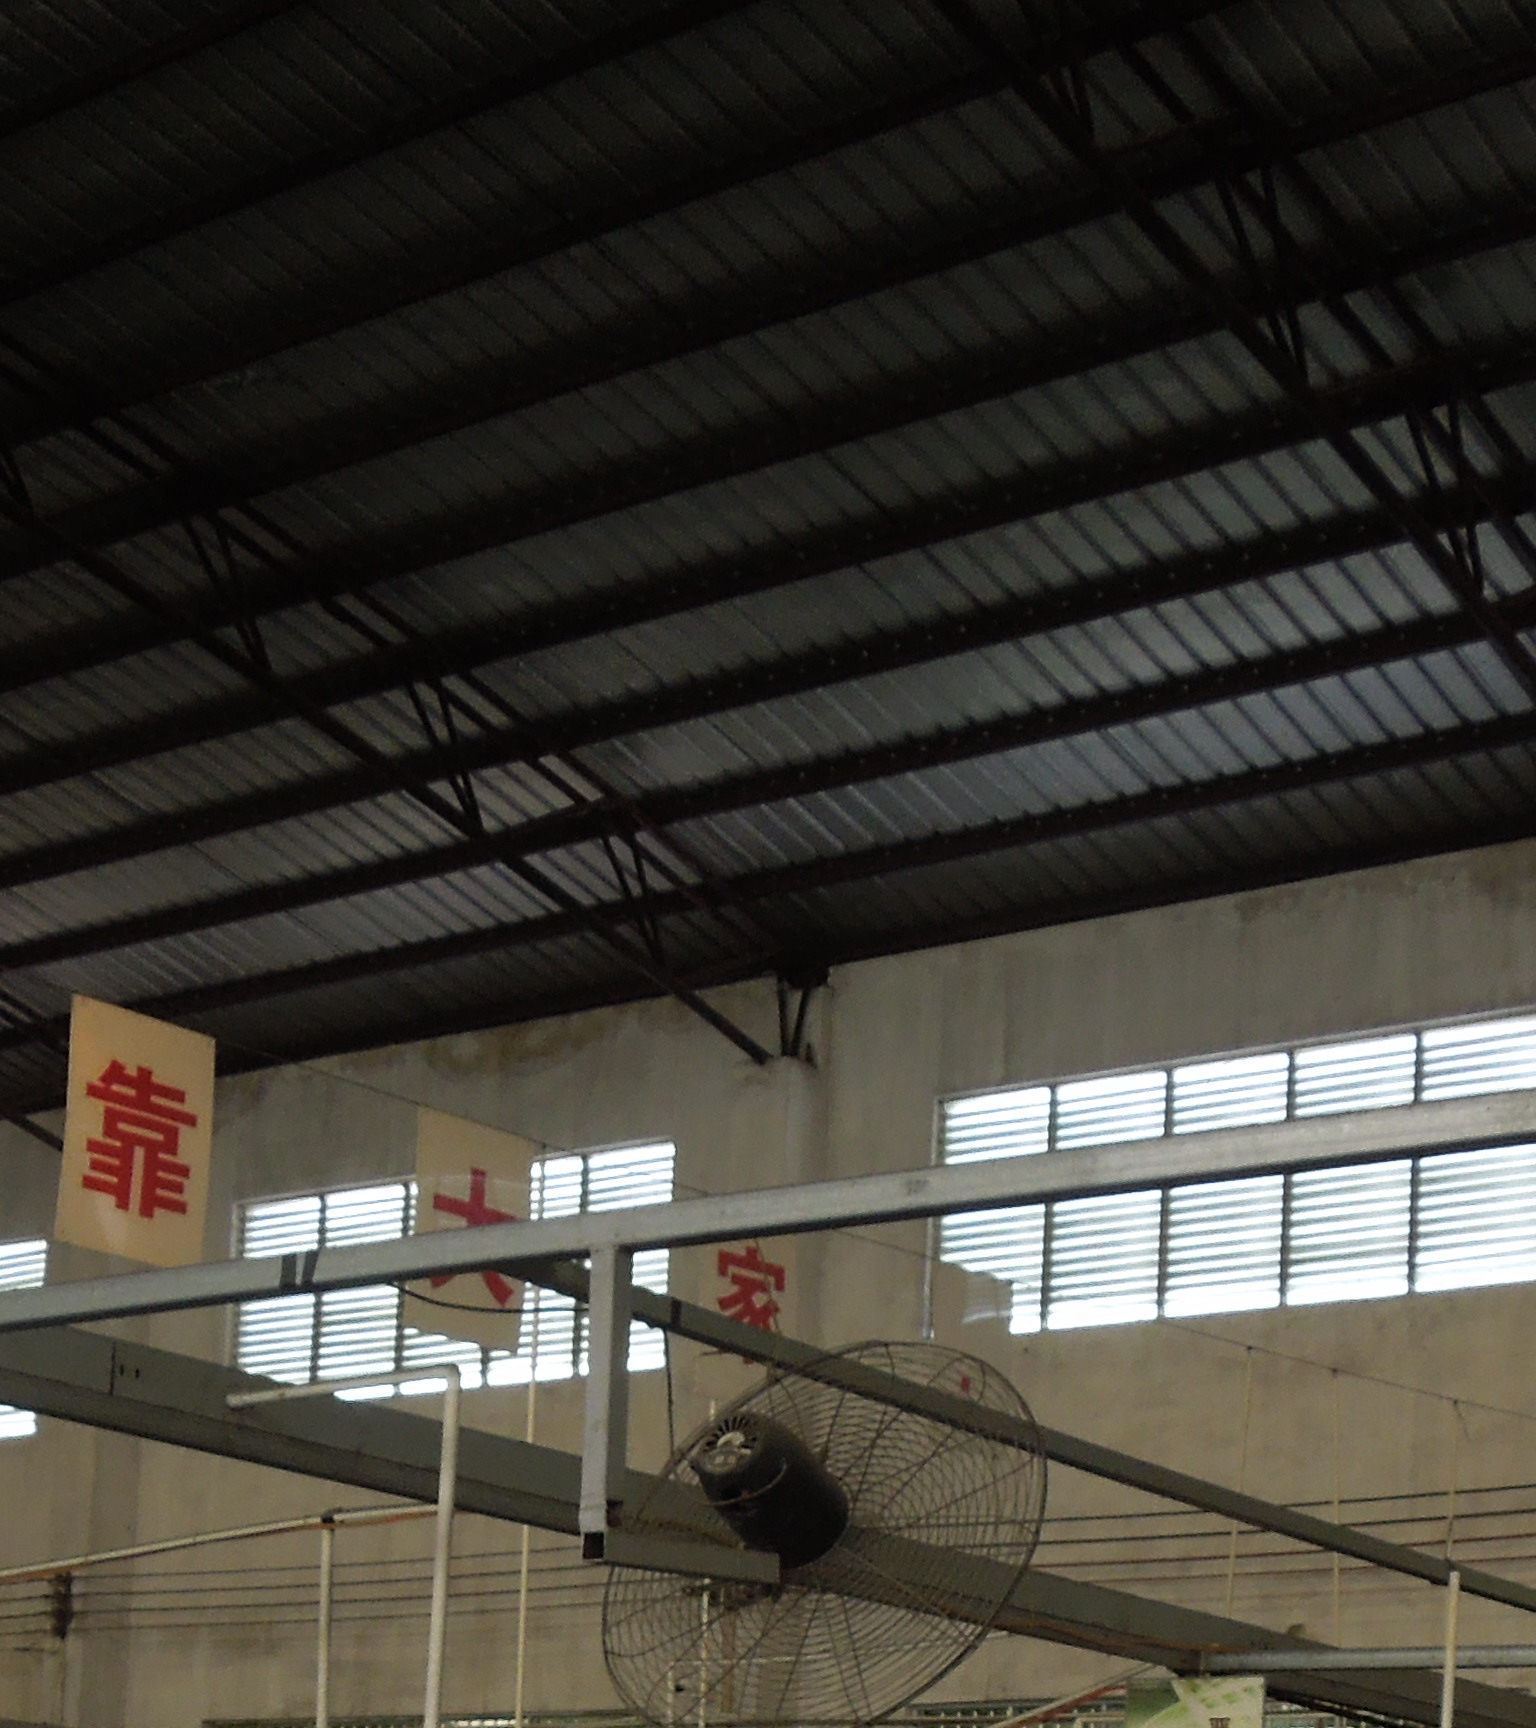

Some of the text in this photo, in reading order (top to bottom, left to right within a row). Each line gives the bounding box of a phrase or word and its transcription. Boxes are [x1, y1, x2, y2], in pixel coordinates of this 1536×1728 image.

[80, 1058, 199, 1220] 靠
[428, 1167, 520, 1308] 大
[716, 1245, 786, 1364] 家
